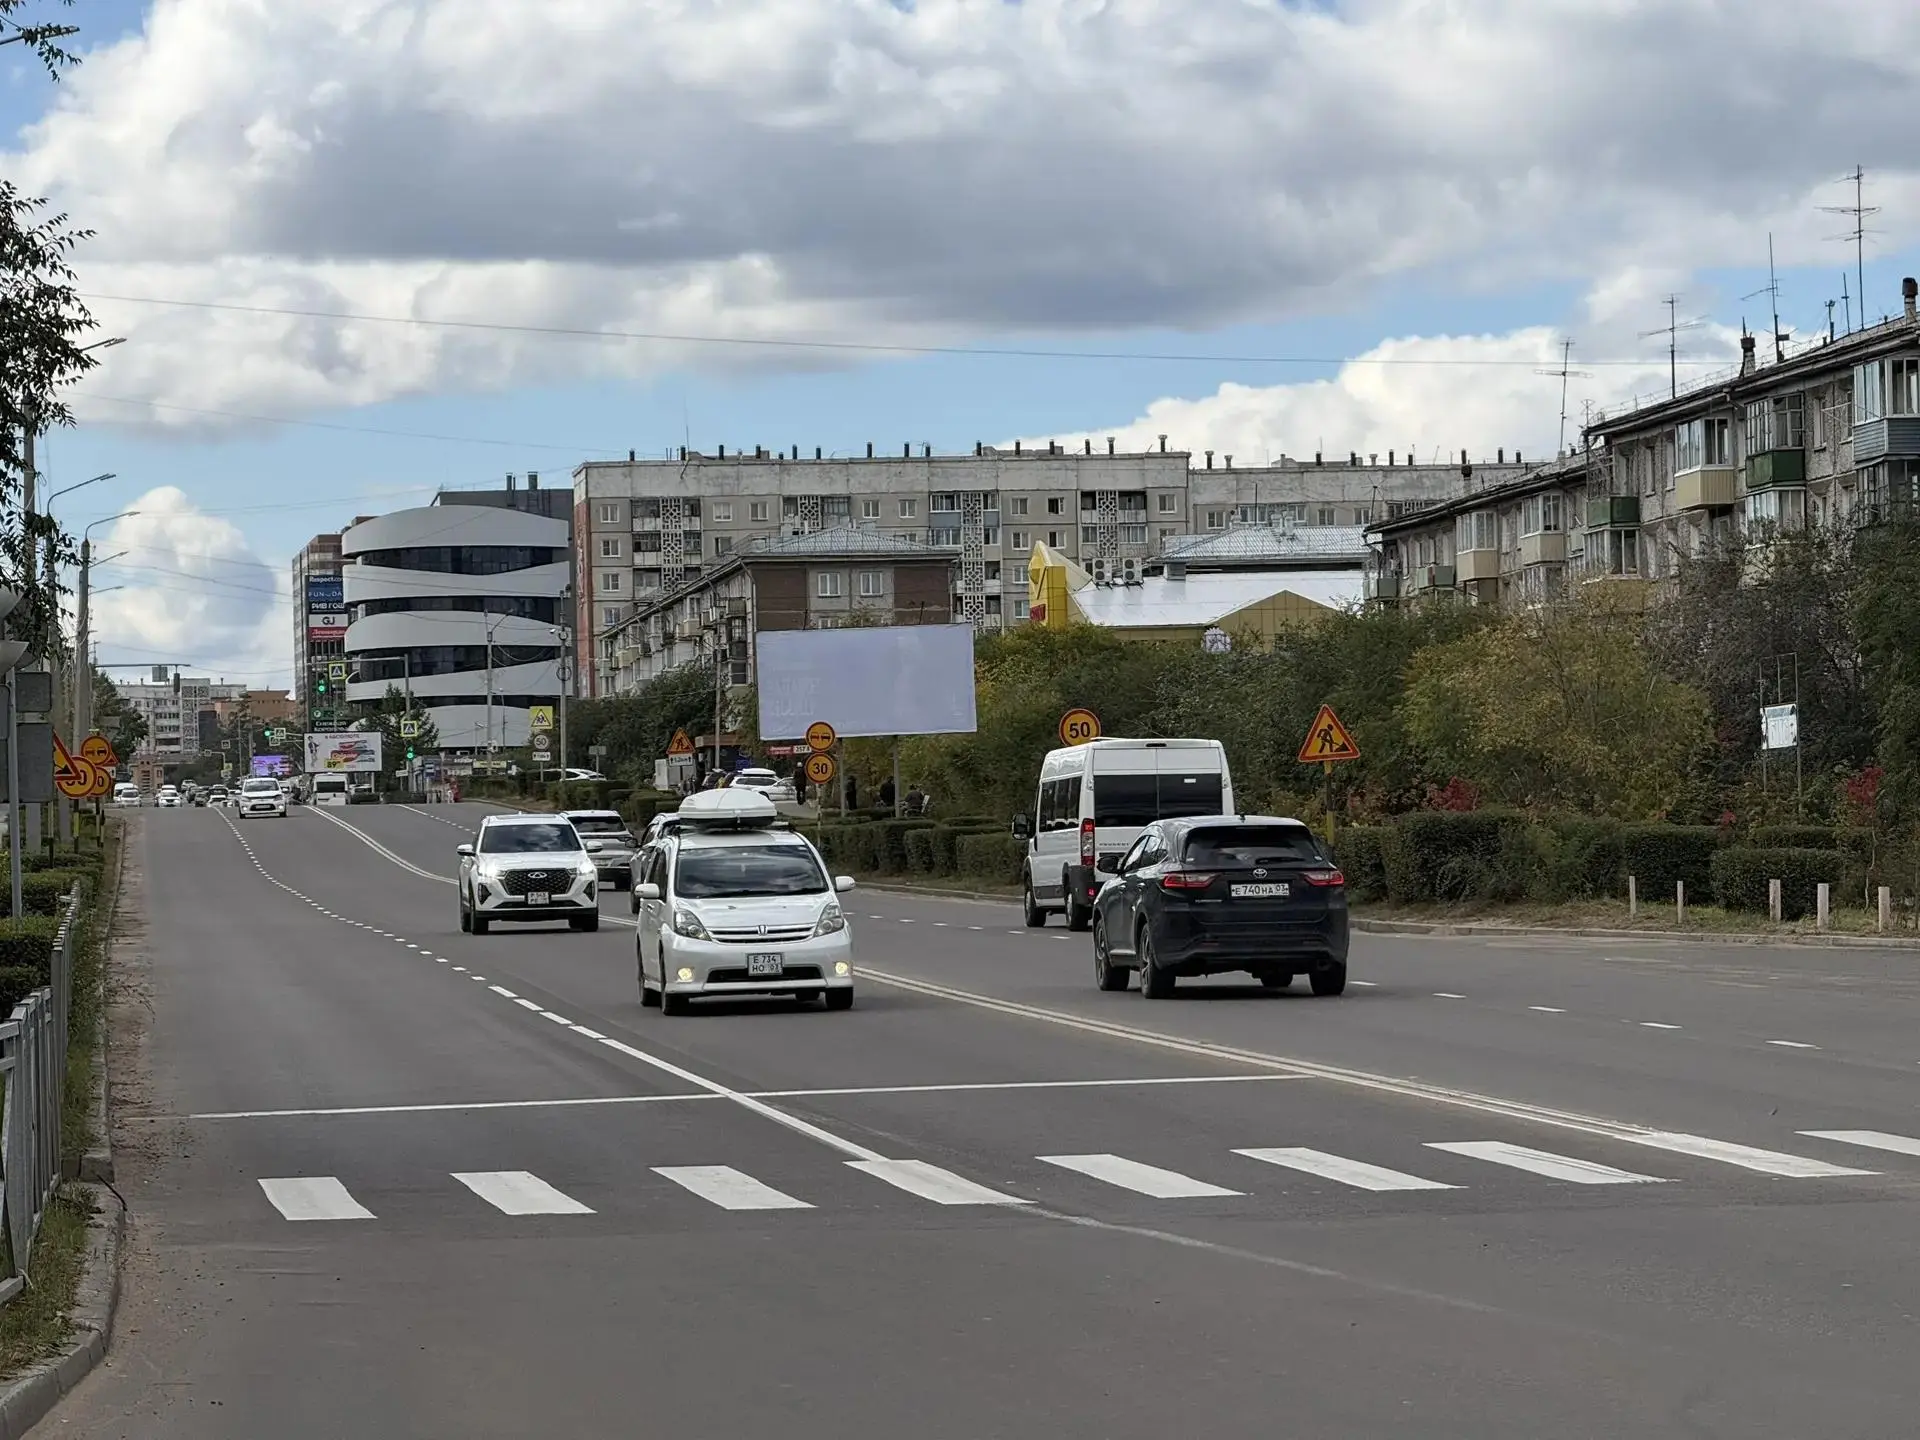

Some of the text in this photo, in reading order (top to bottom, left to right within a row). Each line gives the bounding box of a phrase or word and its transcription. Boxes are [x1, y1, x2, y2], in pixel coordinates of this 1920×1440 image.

[1069, 721, 1091, 739] 50
[535, 737, 548, 746] 50
[812, 762, 828, 775] 30
